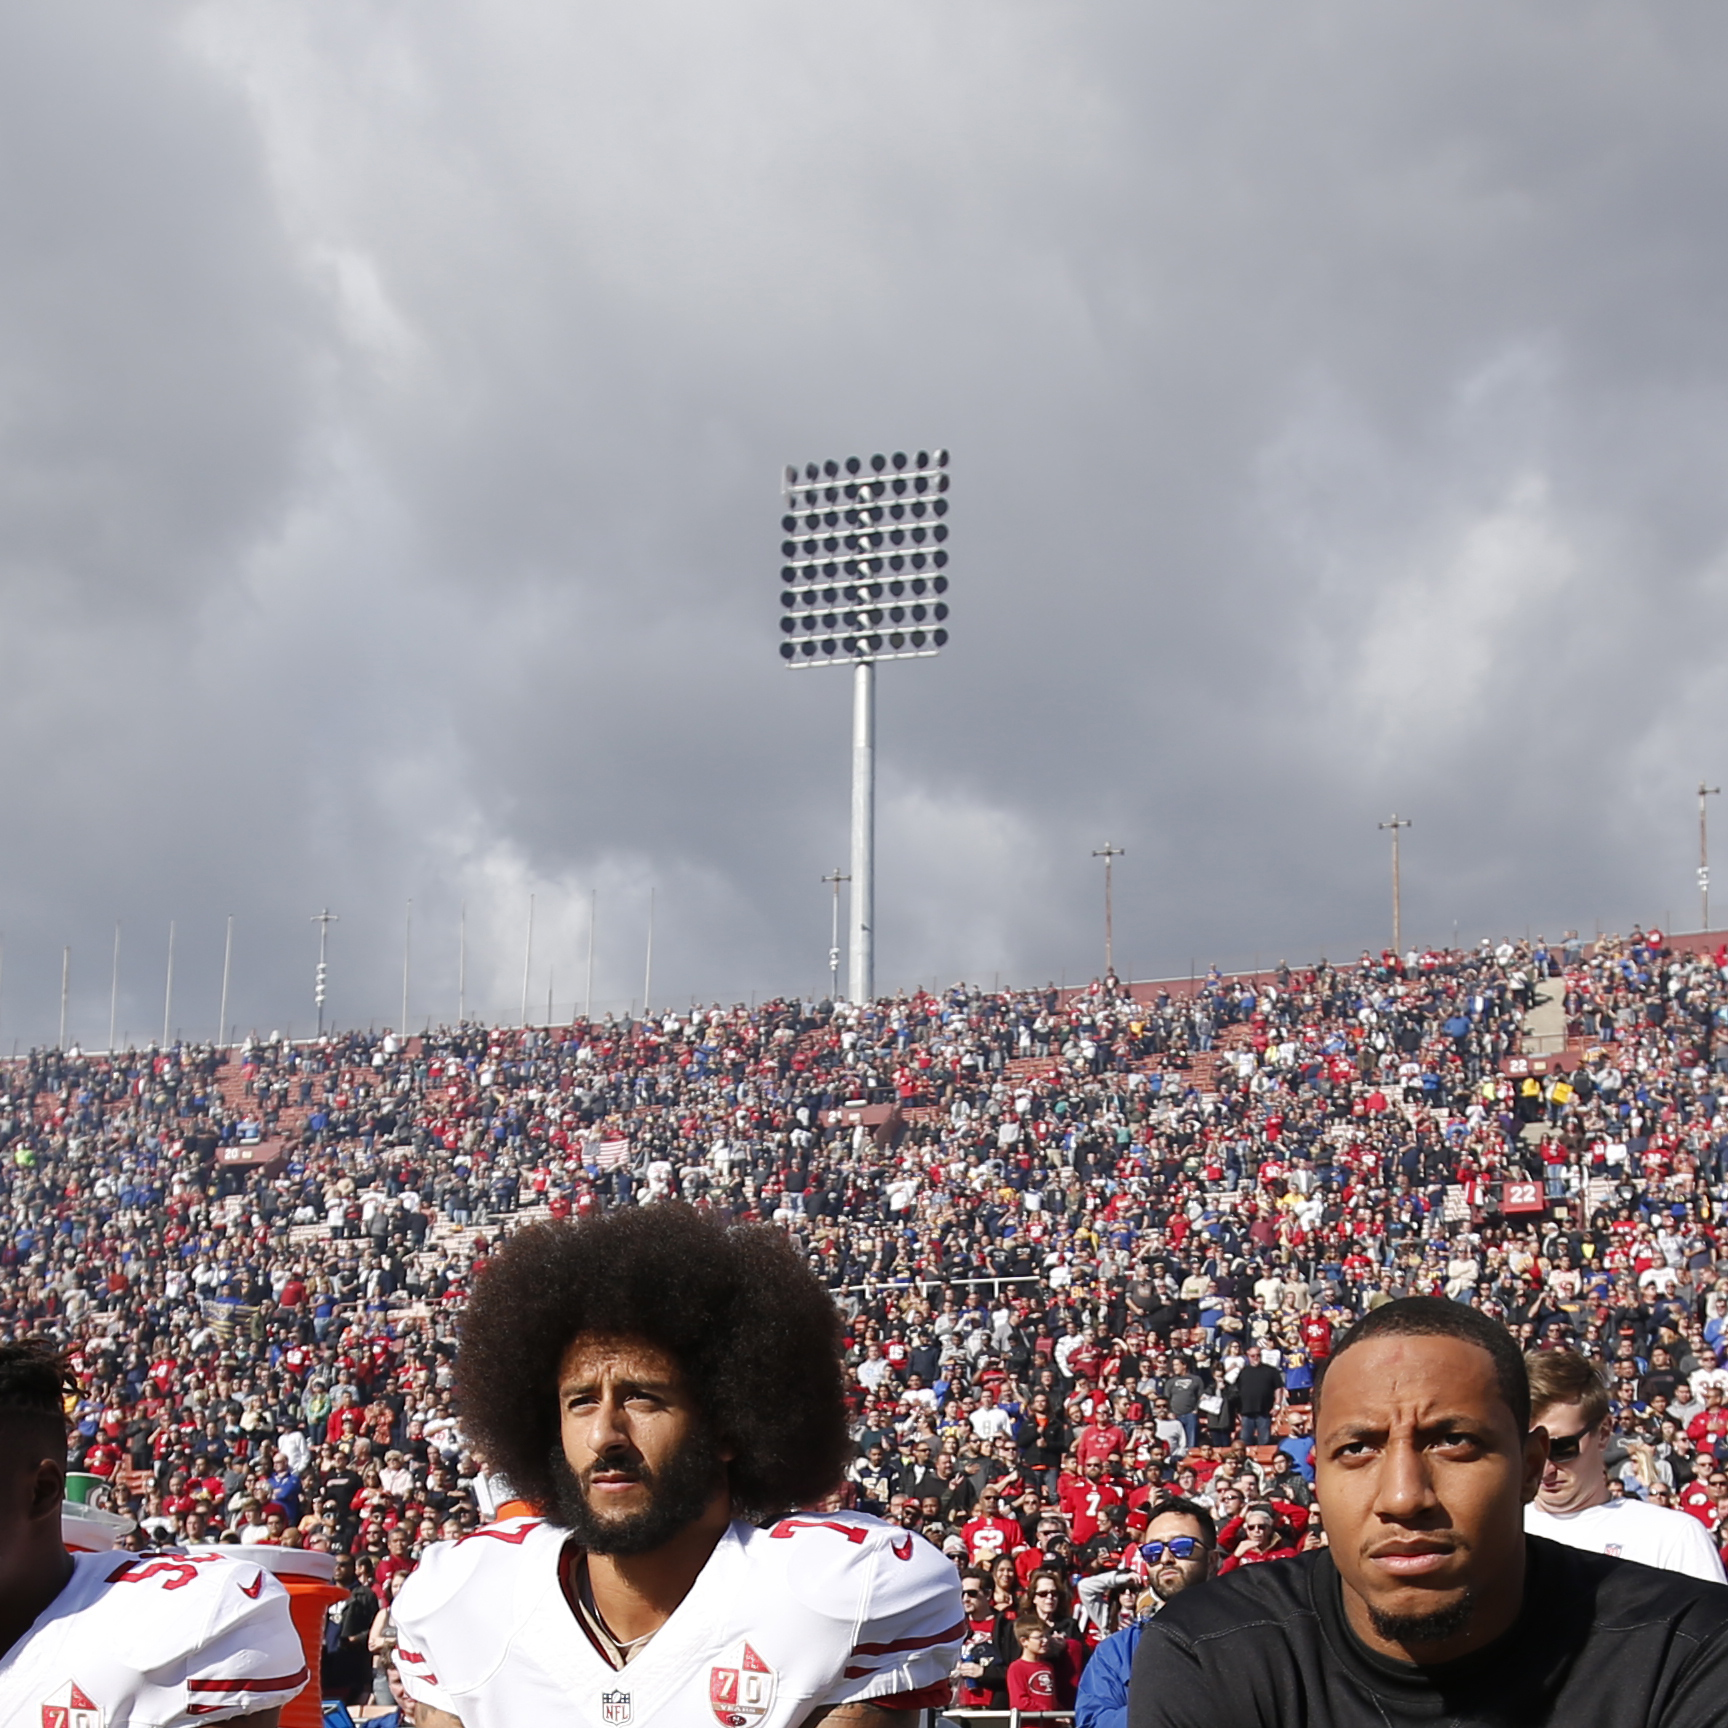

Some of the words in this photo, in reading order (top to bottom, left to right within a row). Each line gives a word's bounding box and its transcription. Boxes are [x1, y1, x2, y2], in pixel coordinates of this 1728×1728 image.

[1509, 1059, 1528, 1073] 22
[224, 1148, 239, 1160] 20
[1509, 1185, 1536, 1203] 22
[1085, 1494, 1101, 1516] 7
[605, 1704, 628, 1721] NFL
